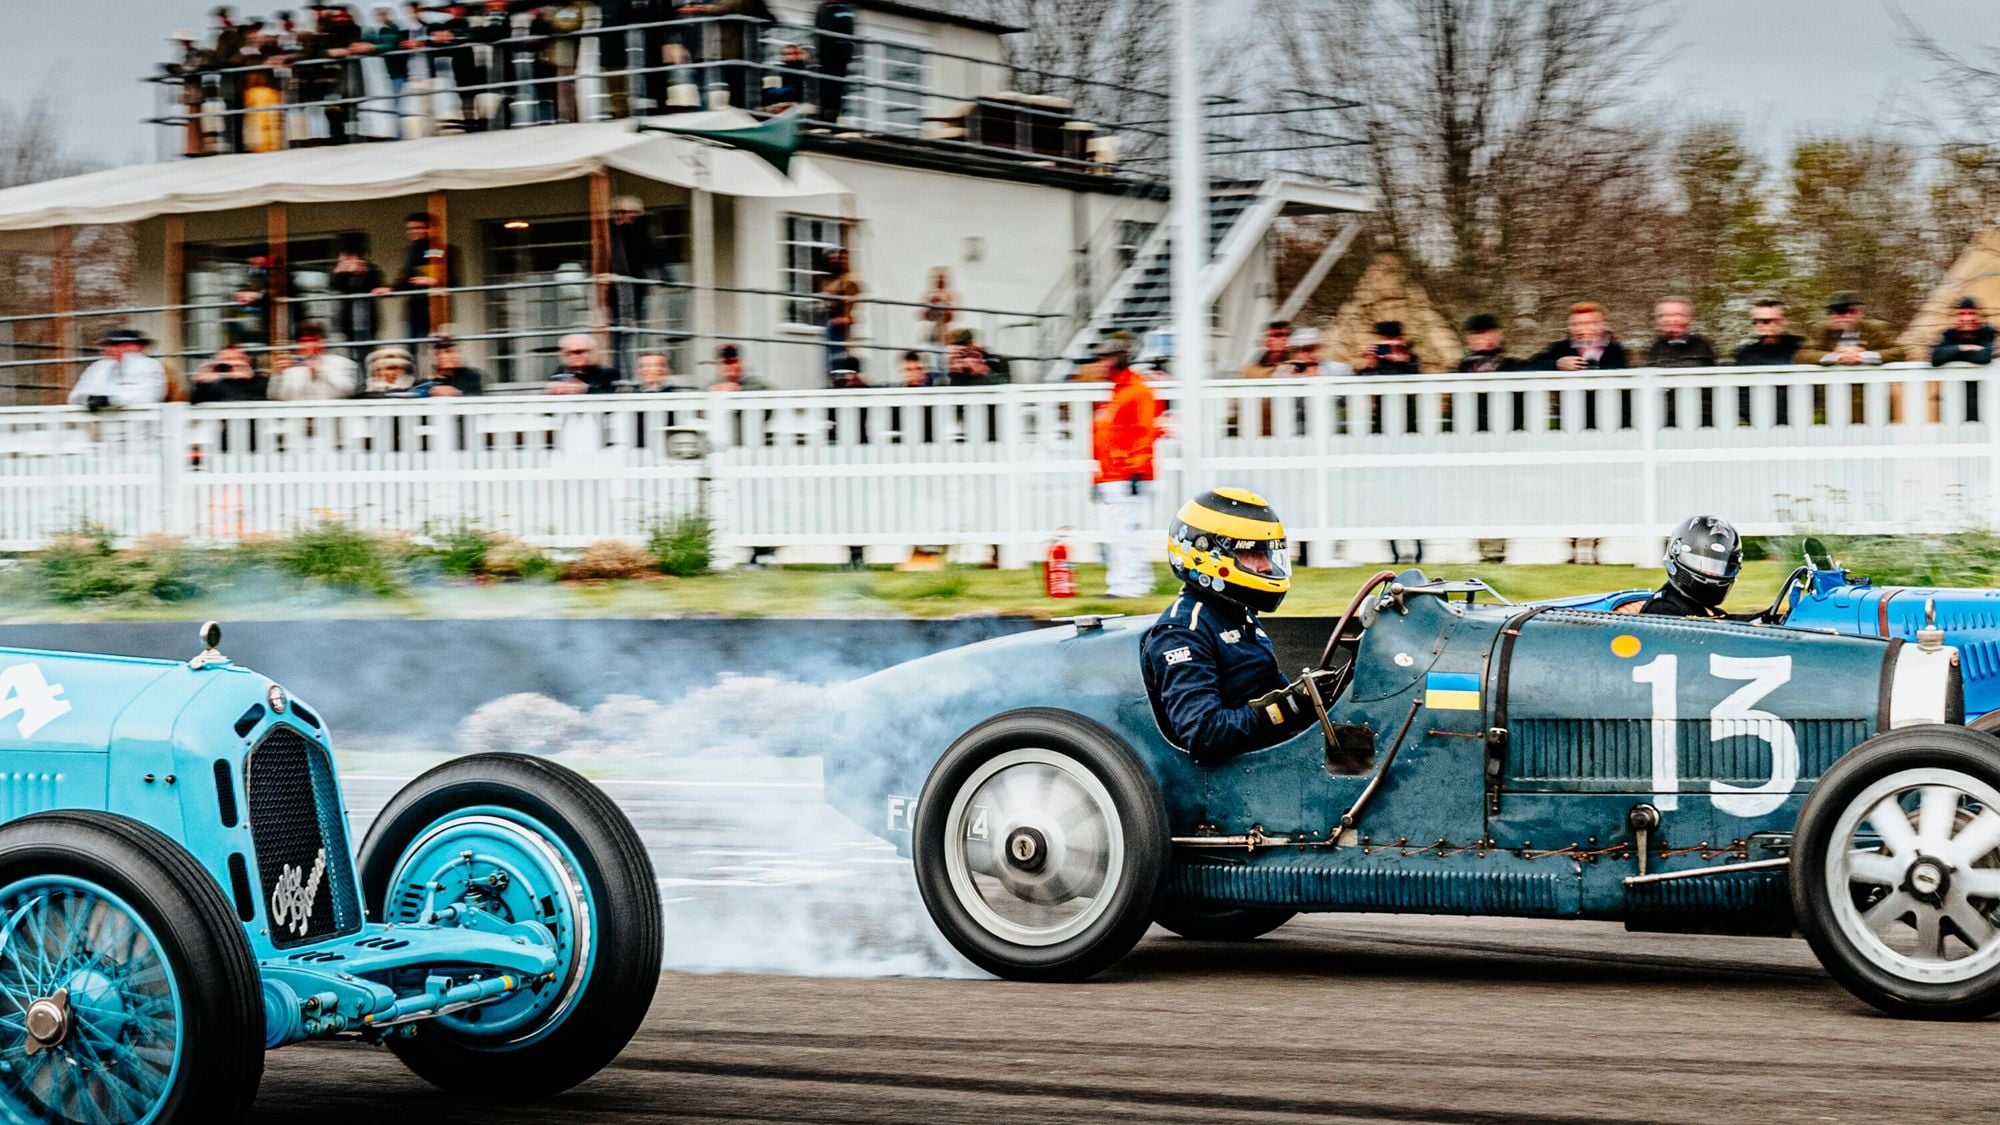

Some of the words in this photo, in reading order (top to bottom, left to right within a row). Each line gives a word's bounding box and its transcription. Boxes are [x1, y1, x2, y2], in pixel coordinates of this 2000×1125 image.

[1164, 648, 1191, 663] OMP
[0, 662, 72, 739] 4
[1632, 653, 1799, 817] 13
[272, 863, 302, 926] Alfa
[289, 848, 326, 937] Romeo
